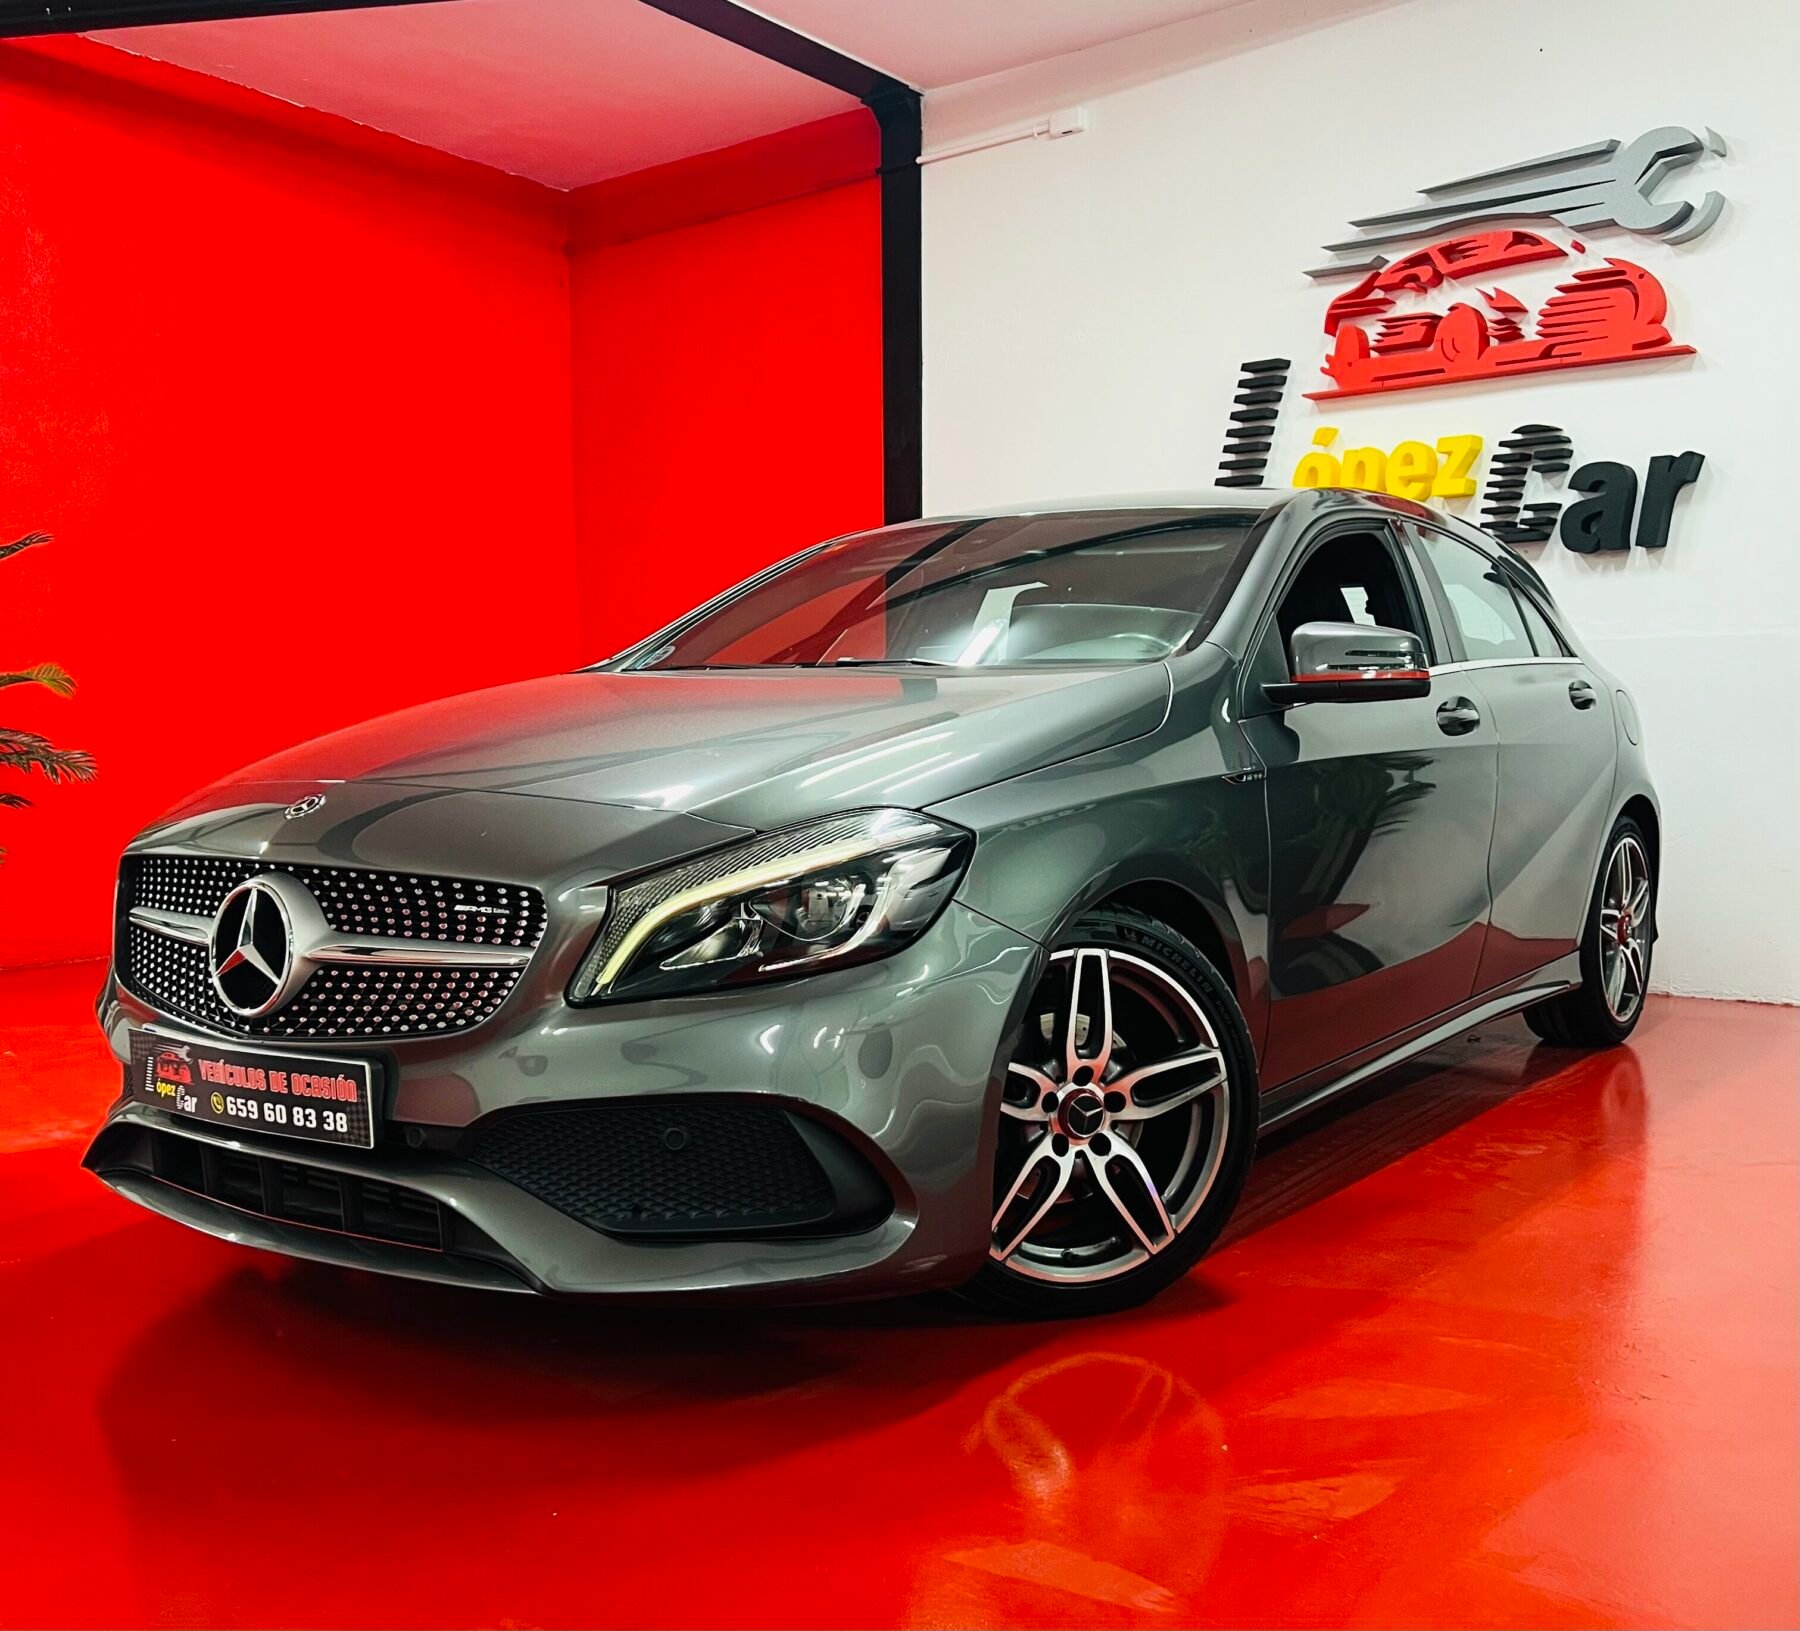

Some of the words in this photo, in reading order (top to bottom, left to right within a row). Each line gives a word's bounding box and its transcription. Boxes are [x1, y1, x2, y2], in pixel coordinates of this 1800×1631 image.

[1481, 424, 1706, 555] Car
[1141, 935, 1213, 993] MICHELIN
[176, 1084, 198, 1113] Car
[198, 1059, 266, 1091] VEHÍCULOS
[269, 1073, 288, 1094] DE
[291, 1074, 358, 1102] OCASIÓN
[226, 1096, 259, 1119] 659
[263, 1103, 287, 1125] 60
[293, 1107, 317, 1129] 83
[323, 1111, 348, 1133] 38
